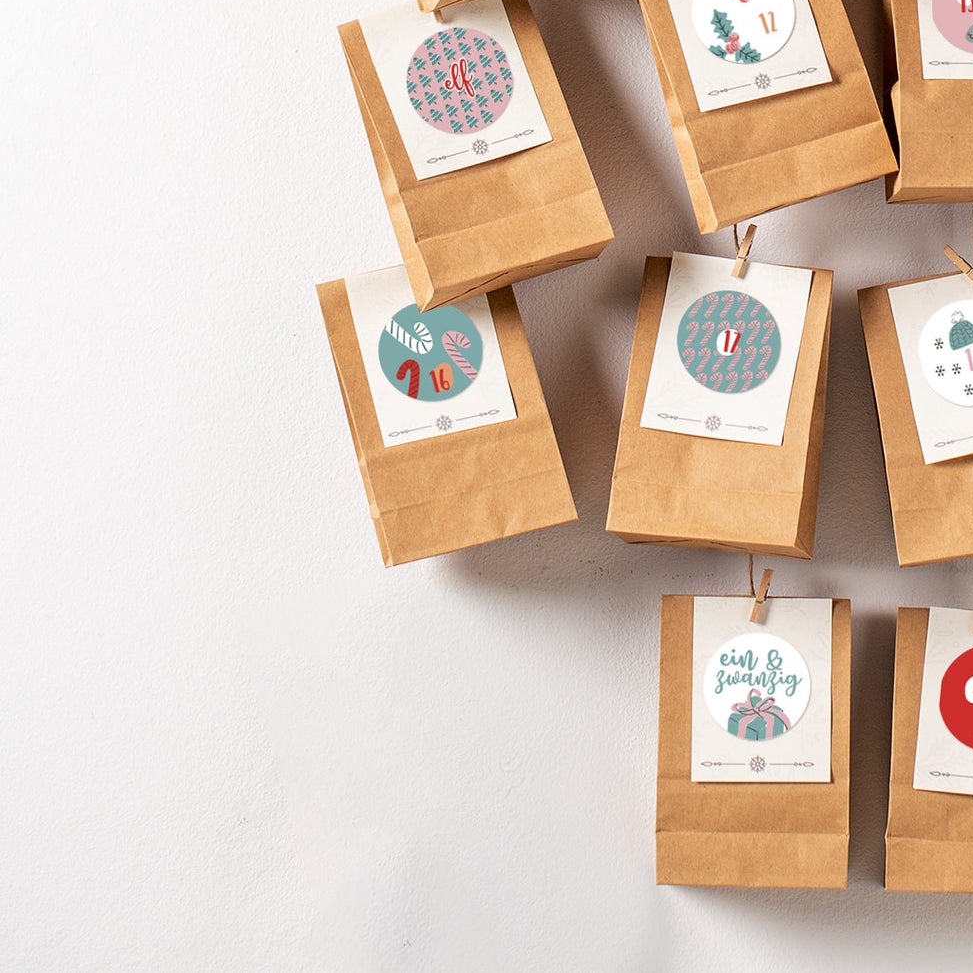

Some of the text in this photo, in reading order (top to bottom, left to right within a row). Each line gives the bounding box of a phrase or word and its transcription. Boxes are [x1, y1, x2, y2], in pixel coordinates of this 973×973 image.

[758, 11, 778, 34] 12
[444, 58, 474, 98] elf
[723, 329, 742, 353] 17
[429, 368, 450, 393] 16
[719, 649, 783, 671] ein &
[715, 668, 802, 697] zwanzig
